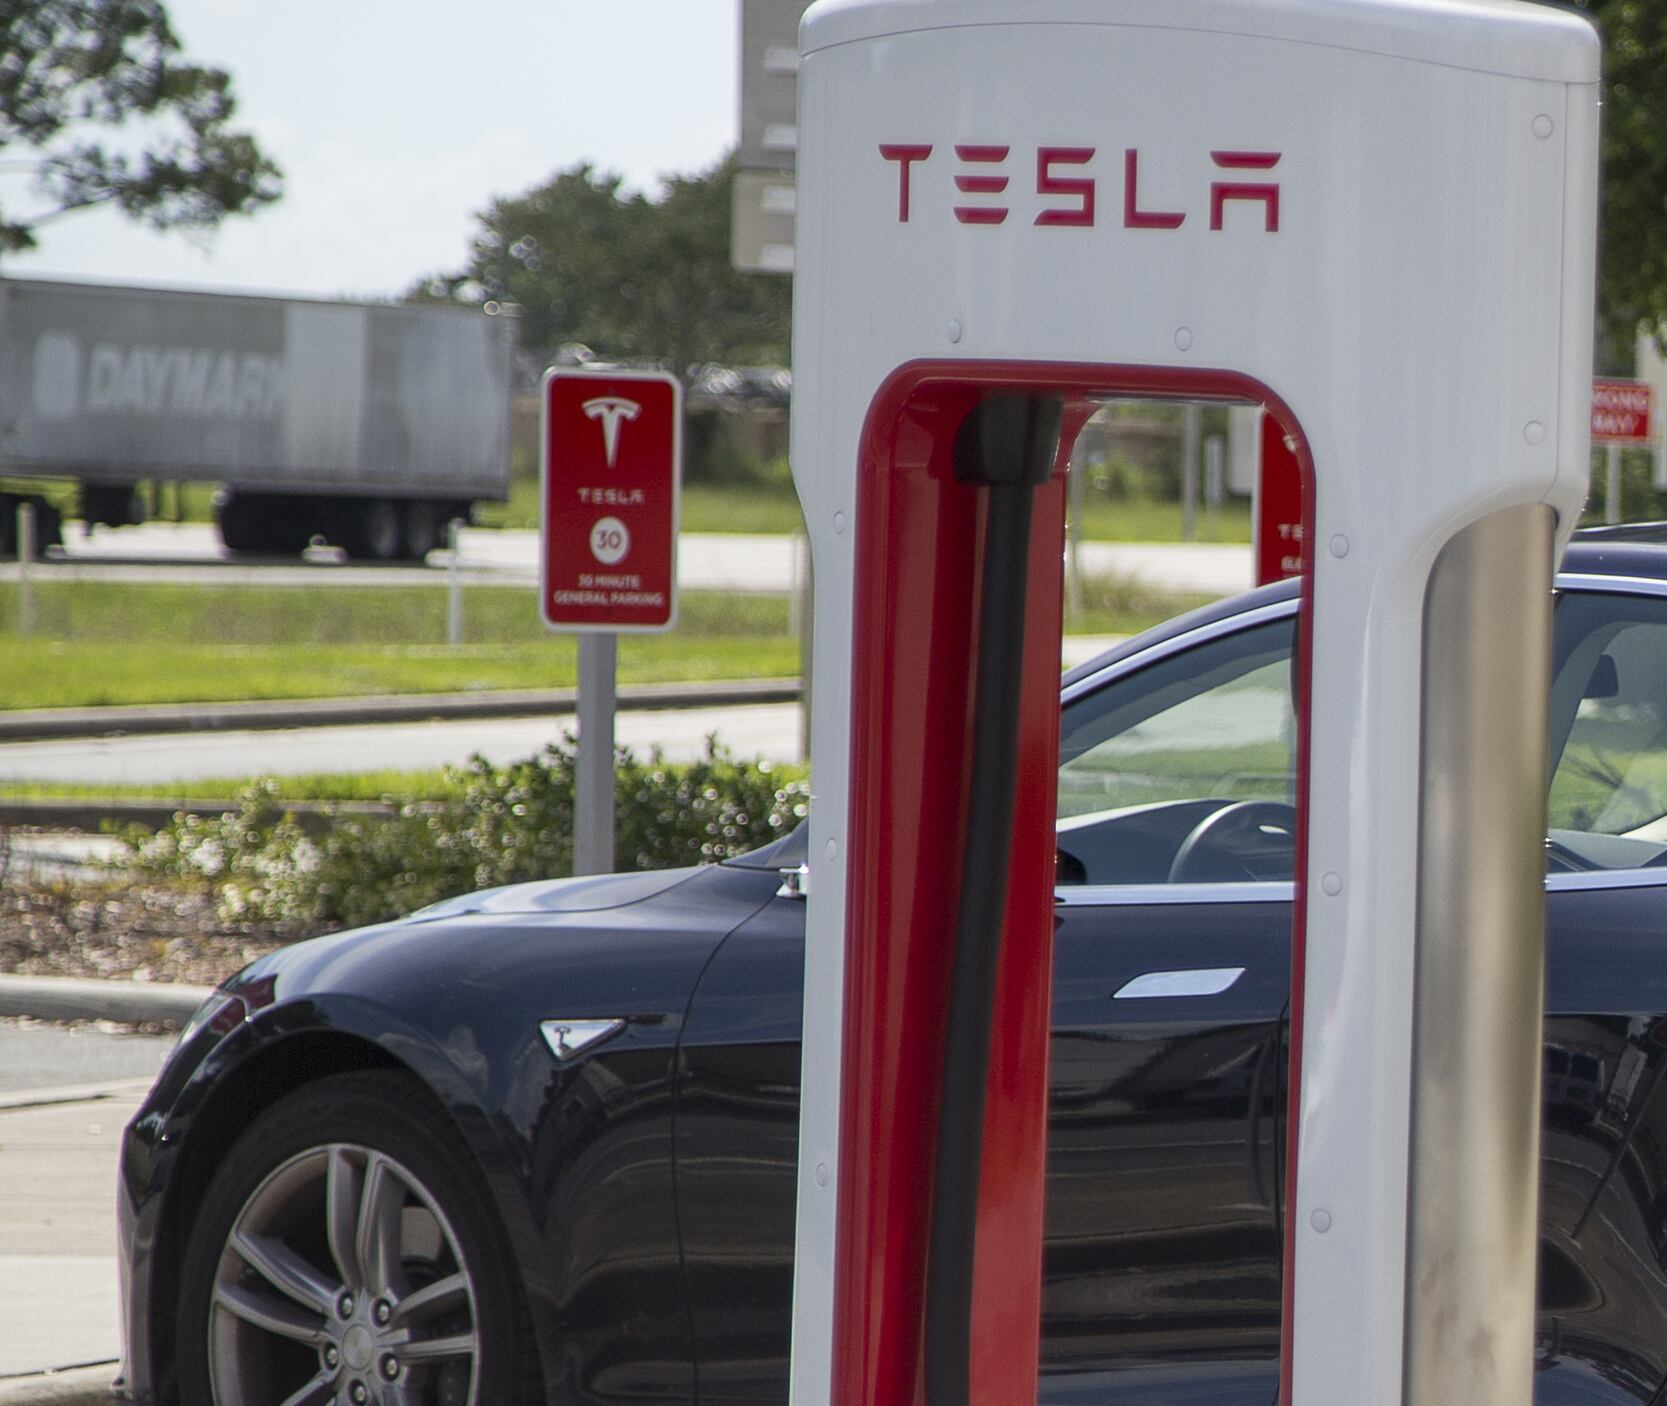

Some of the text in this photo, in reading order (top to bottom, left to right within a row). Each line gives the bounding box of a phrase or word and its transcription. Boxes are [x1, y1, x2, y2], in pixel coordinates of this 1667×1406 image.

[878, 143, 1282, 232] TESLA
[577, 487, 646, 505] TESLA
[596, 529, 622, 550] 30
